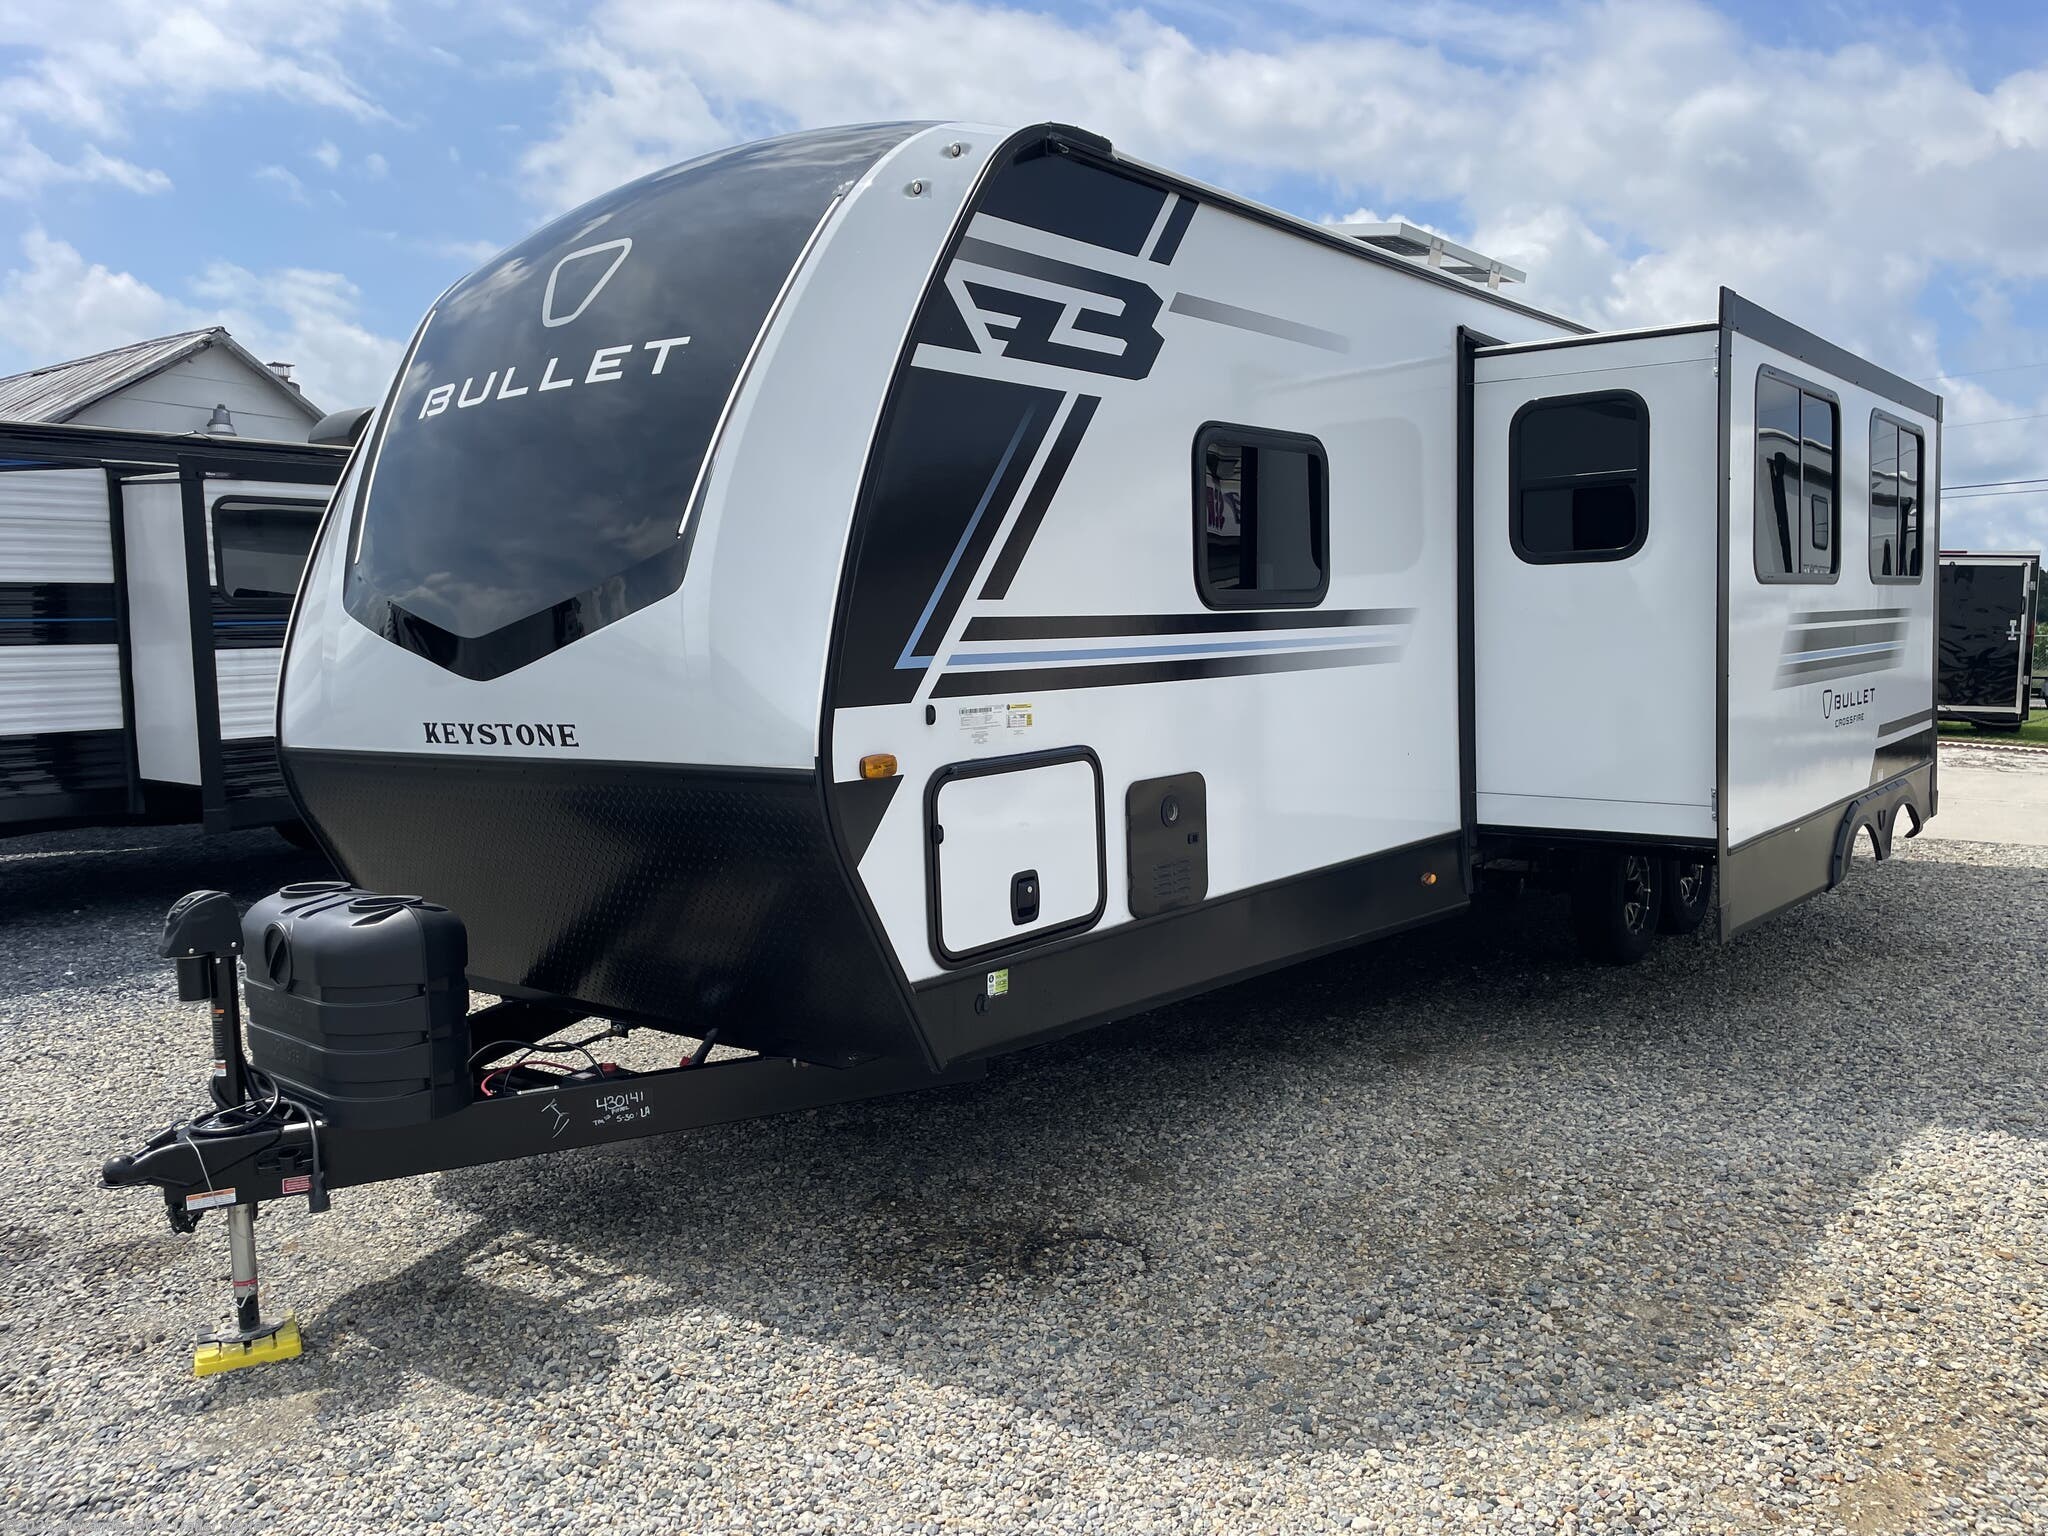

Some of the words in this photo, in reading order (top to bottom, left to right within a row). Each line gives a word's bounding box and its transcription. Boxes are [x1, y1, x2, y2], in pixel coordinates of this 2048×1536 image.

[418, 336, 692, 420] BULLET
[1835, 688, 1875, 710] BULLET
[1835, 713, 1864, 727] CROSSFIRE
[423, 722, 579, 748] KEYSTONE
[595, 1091, 644, 1111] 430141
